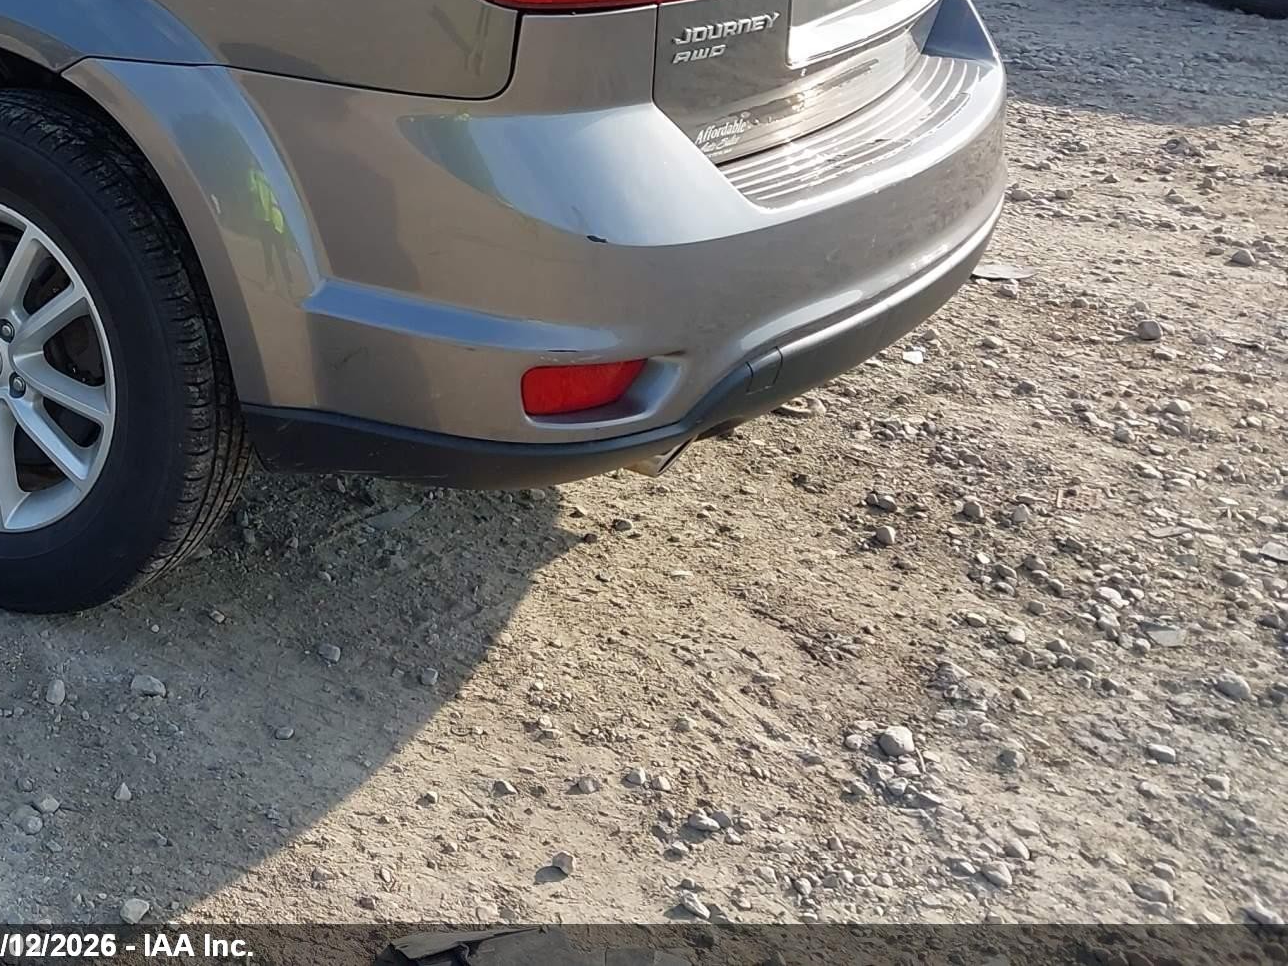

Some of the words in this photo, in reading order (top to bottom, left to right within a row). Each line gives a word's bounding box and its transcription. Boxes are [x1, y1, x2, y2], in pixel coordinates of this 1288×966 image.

[673, 12, 780, 44] JOURNEY
[672, 44, 726, 64] AWD
[695, 119, 746, 144] Affordable
